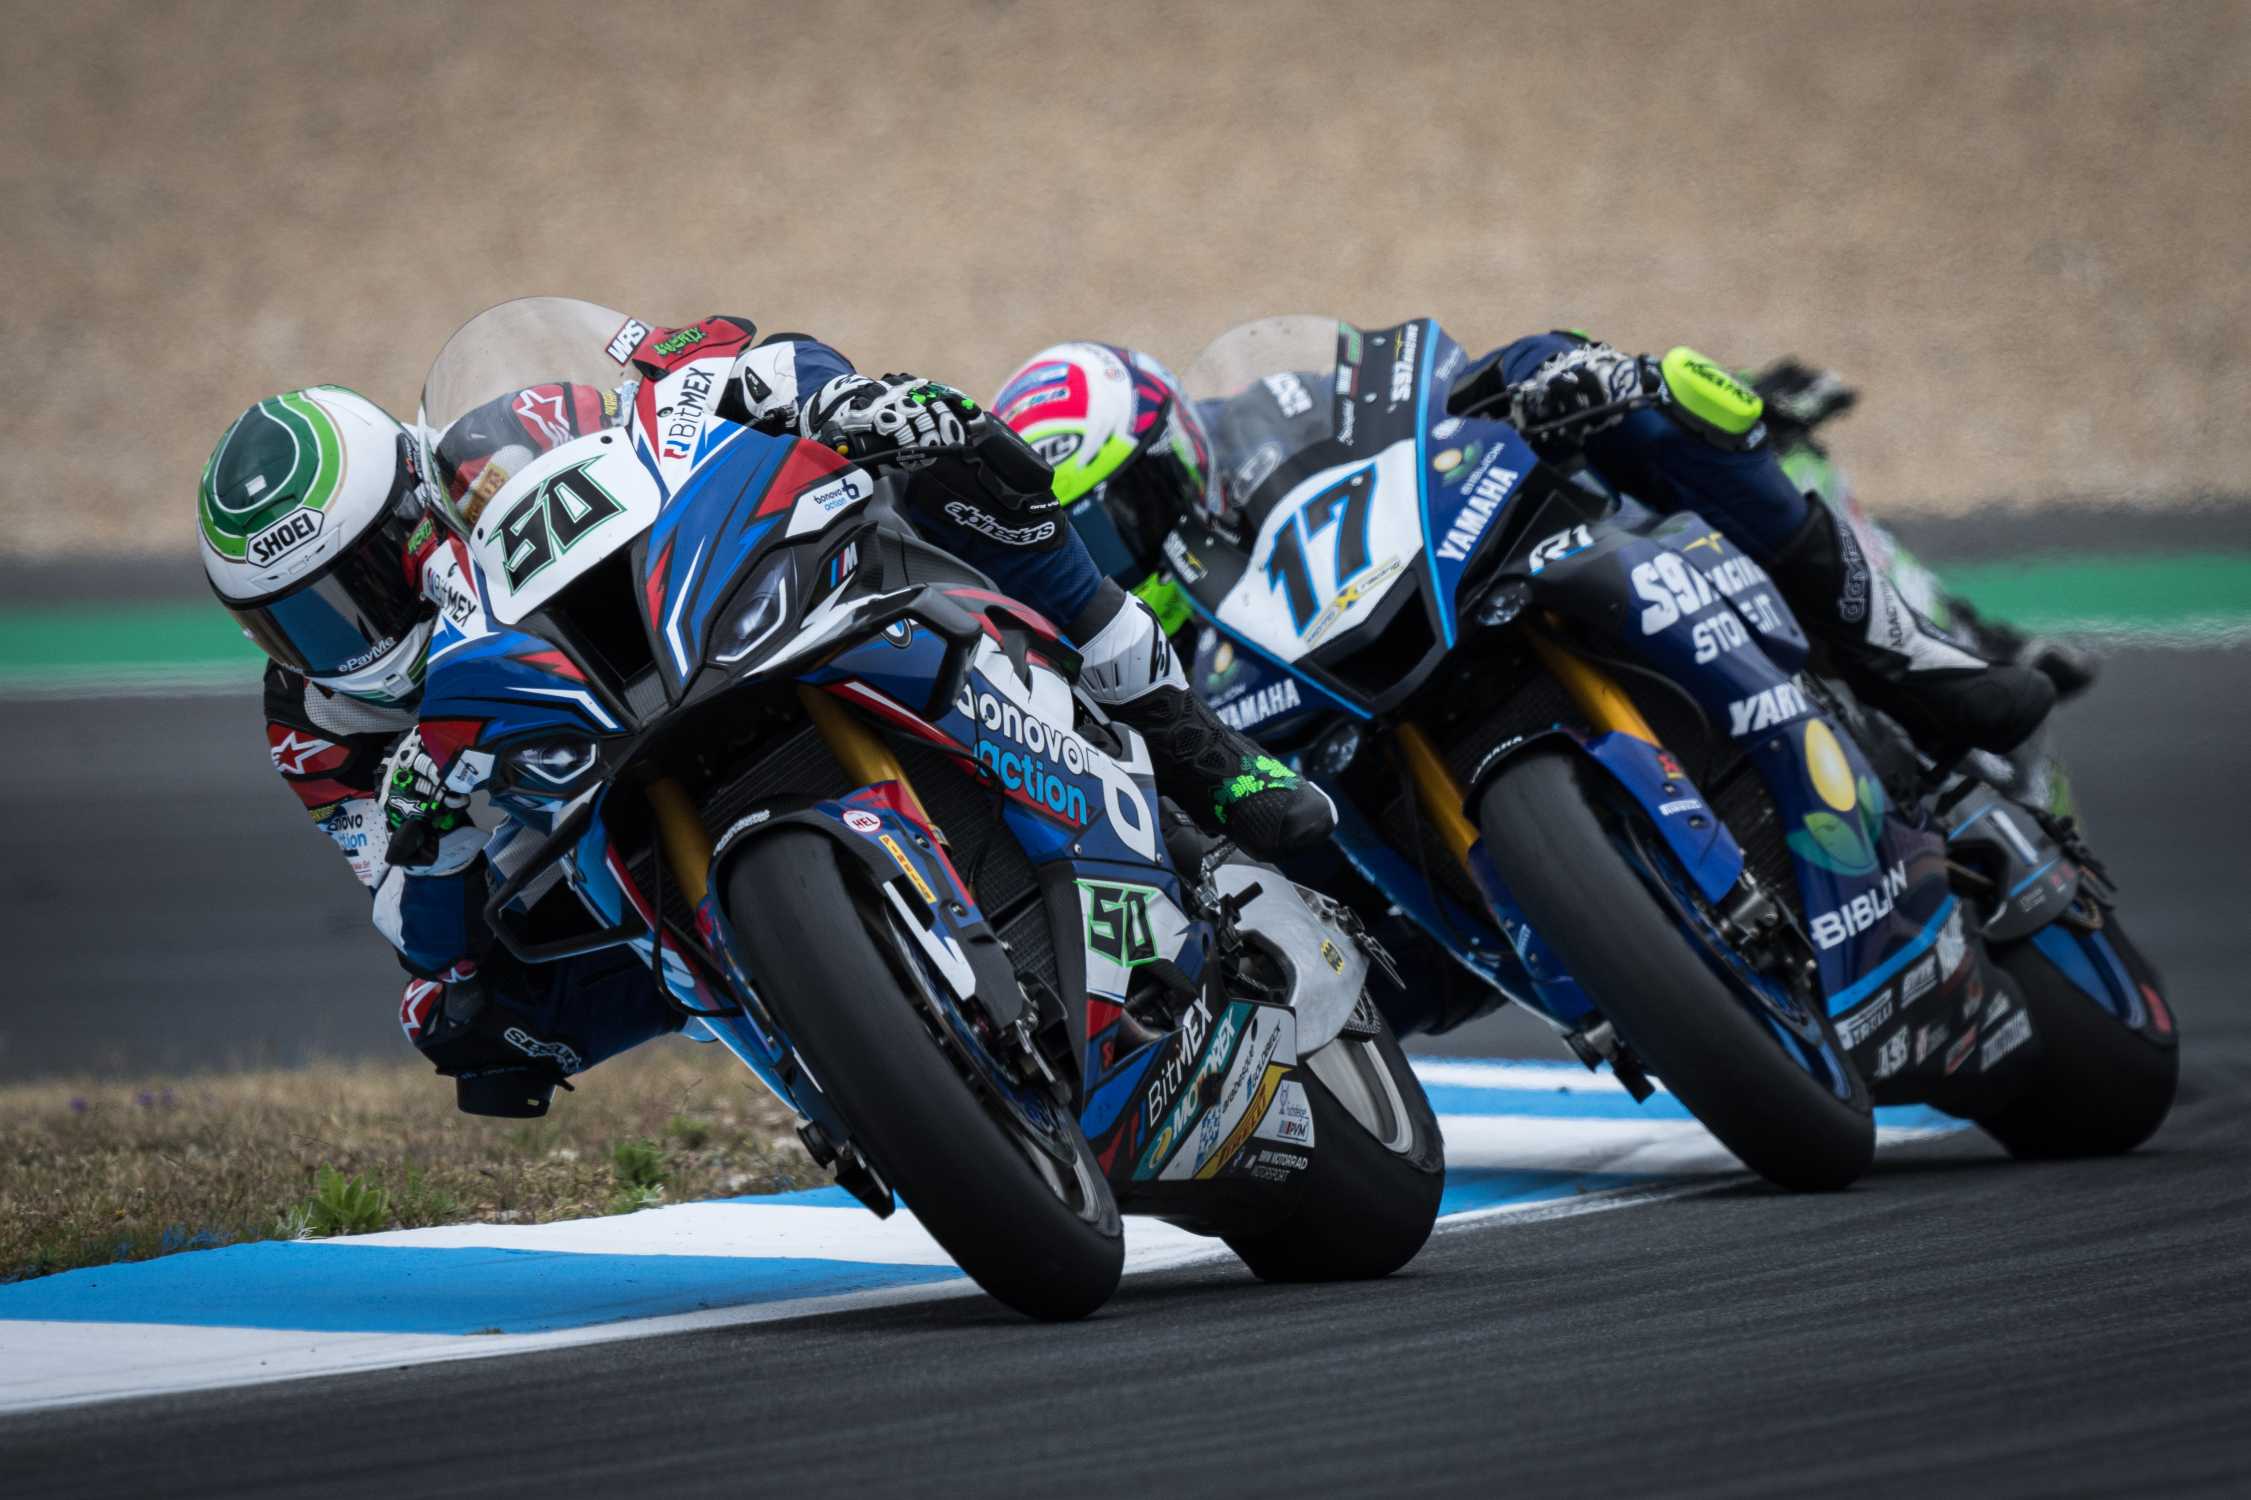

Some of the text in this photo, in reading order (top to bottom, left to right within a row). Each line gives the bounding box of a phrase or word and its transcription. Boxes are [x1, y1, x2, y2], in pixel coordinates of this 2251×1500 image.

[606, 319, 650, 365] WRS
[669, 367, 715, 439] BitMEX
[252, 513, 317, 563] SHOEI
[485, 454, 628, 597] 50
[1264, 457, 1379, 638] 17
[1436, 466, 1519, 562] YAMAHA
[975, 740, 1088, 825] action
[1074, 879, 1159, 968] 50
[1149, 984, 1213, 1128] BitMEX
